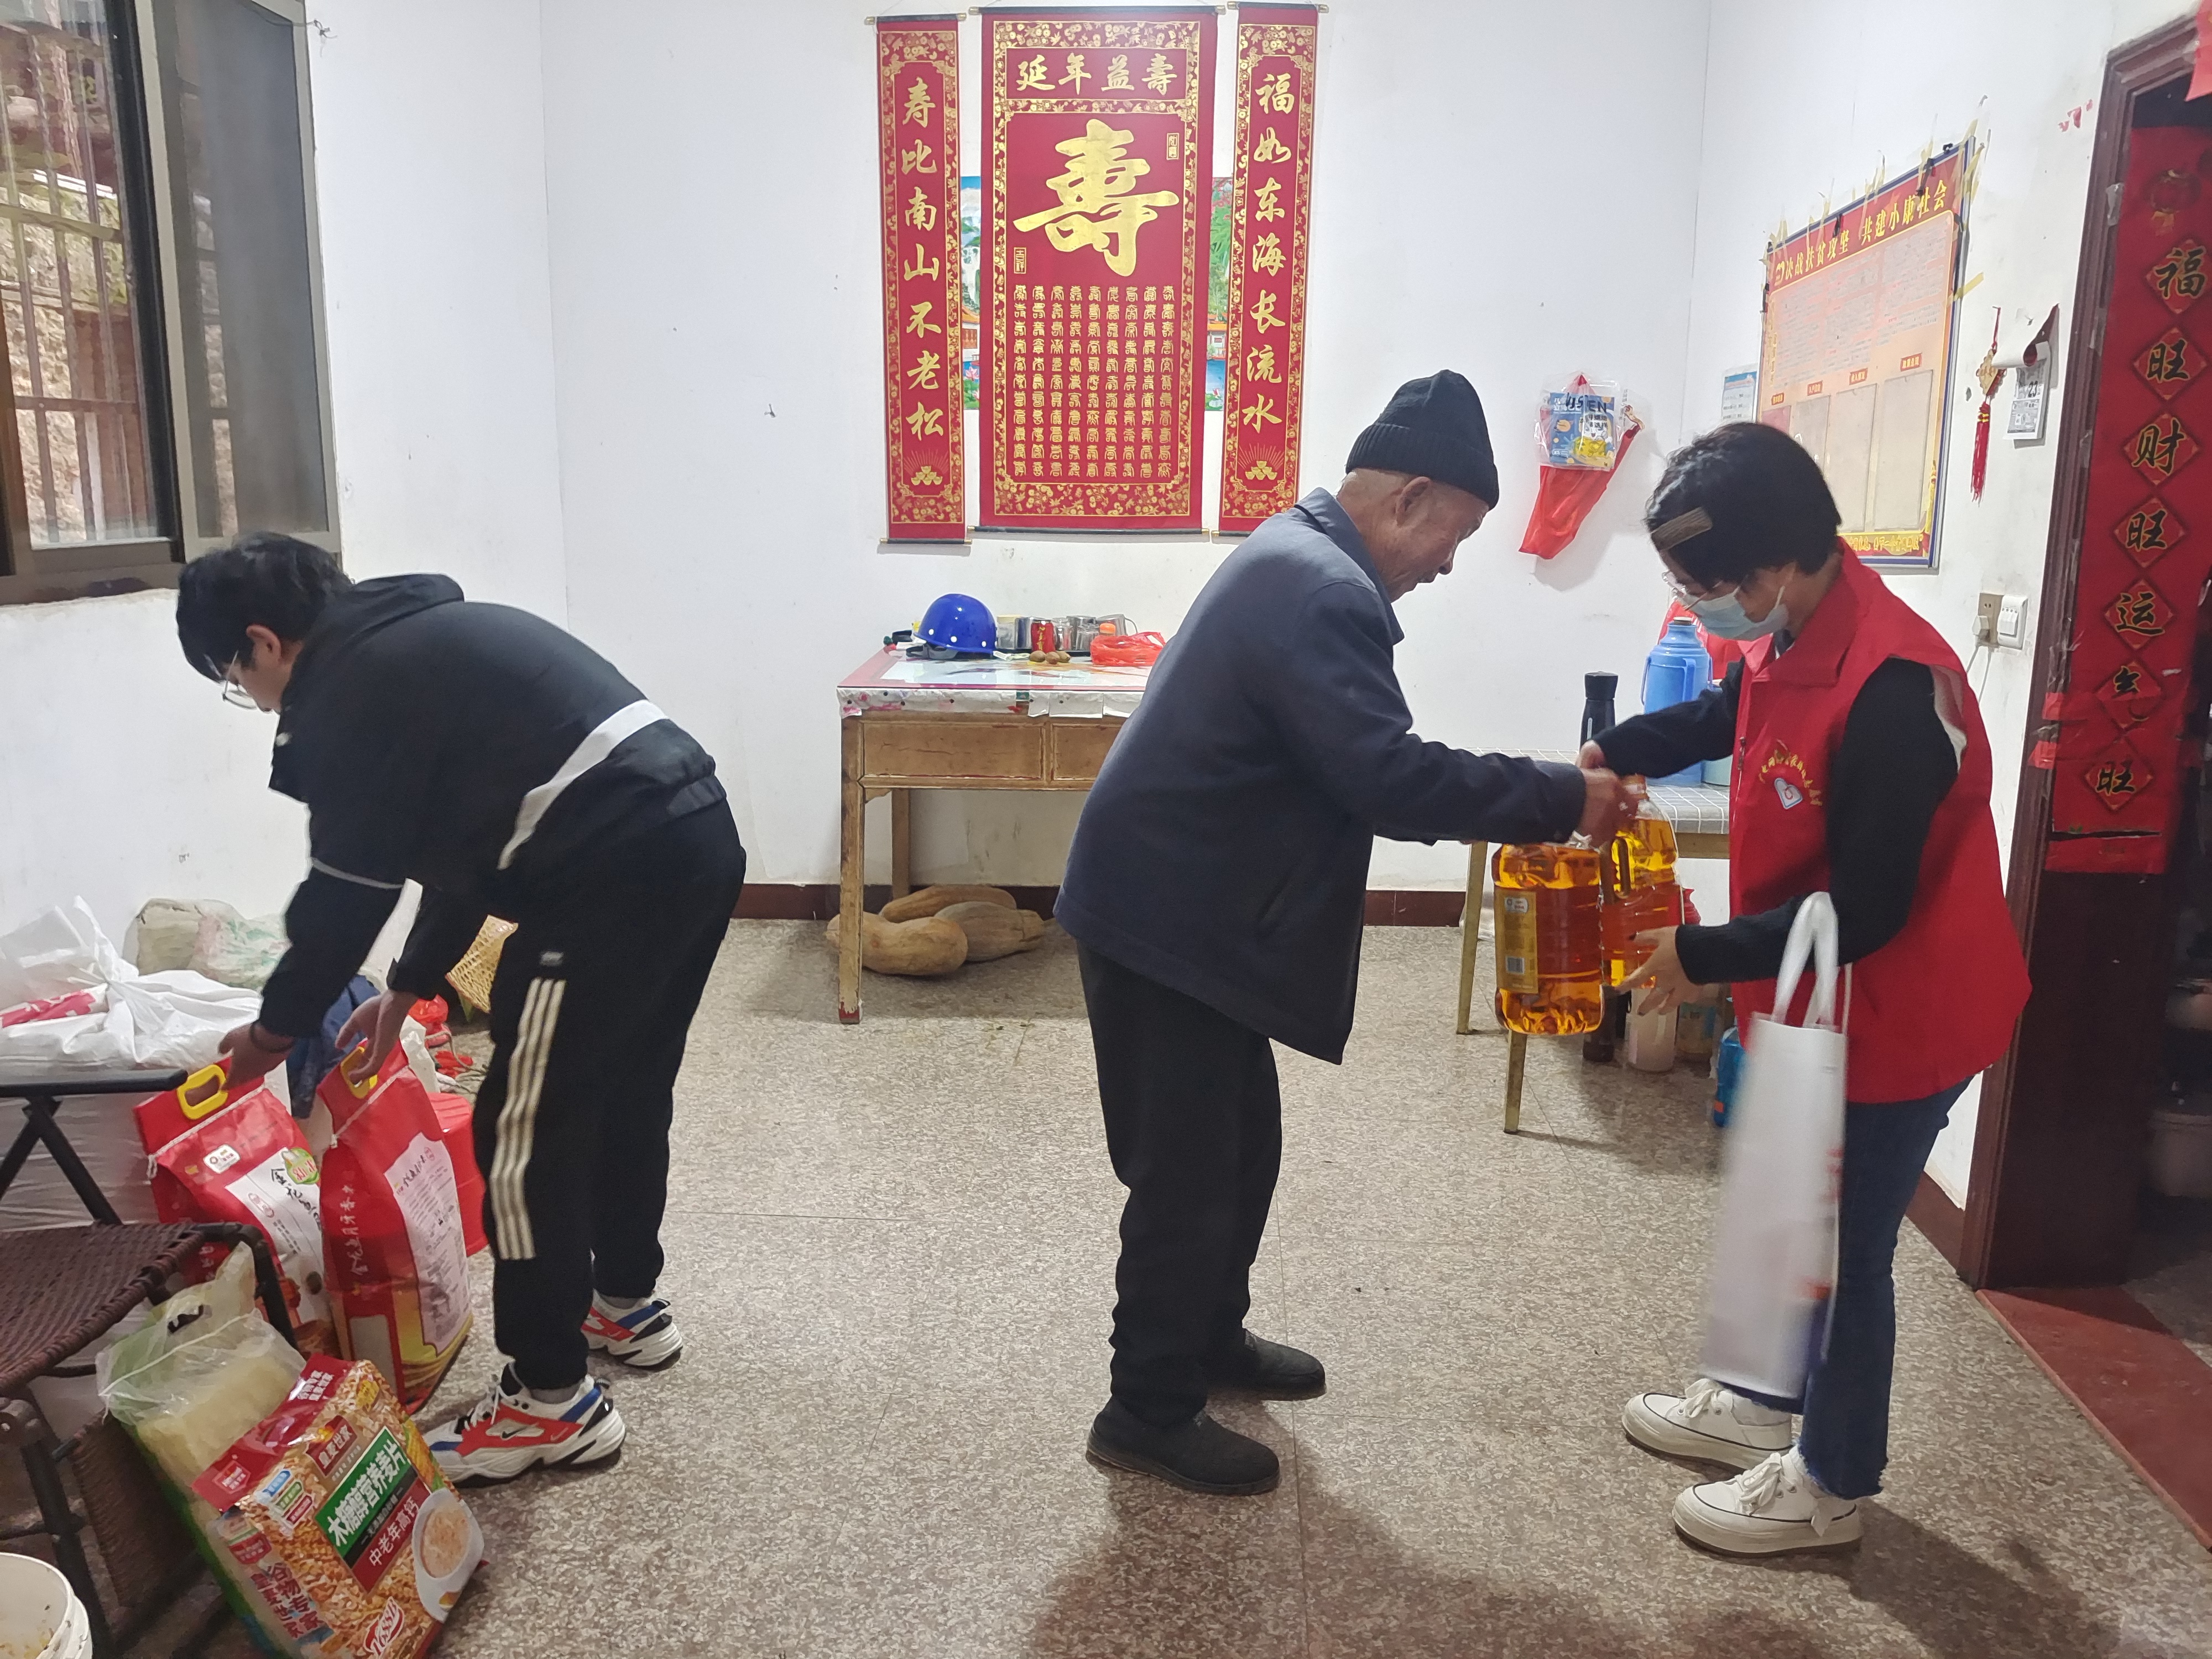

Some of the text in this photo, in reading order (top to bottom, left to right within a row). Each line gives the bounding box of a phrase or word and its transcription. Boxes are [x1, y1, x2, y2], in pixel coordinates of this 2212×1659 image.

[901, 76, 944, 441] 寿比南山不老松
[1241, 73, 1295, 434] 福如东海长流水
[327, 1440, 406, 1547] 木糖醇营养麦片
[368, 1498, 419, 1568] 中老年高钙
[267, 1562, 324, 1629] 谷物专家
